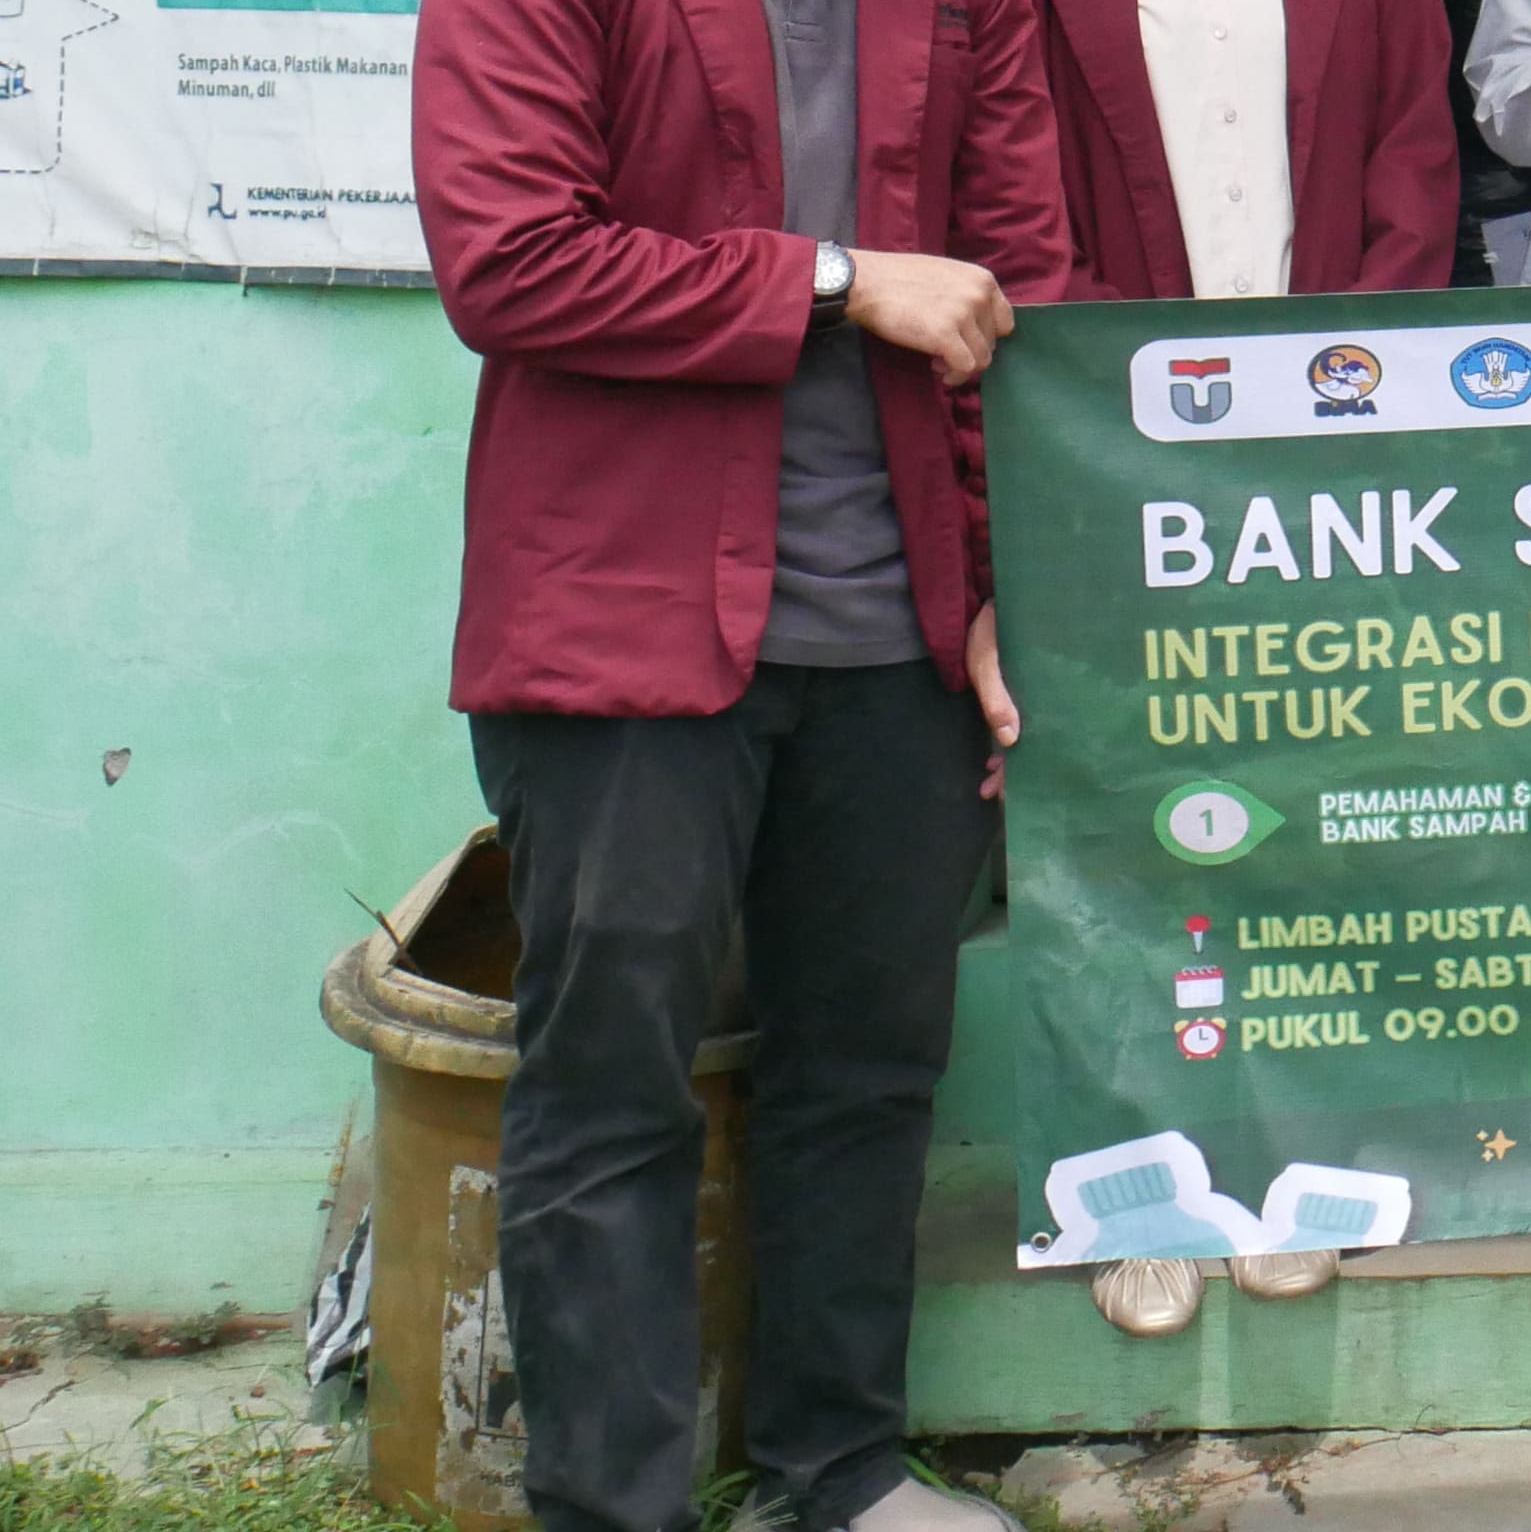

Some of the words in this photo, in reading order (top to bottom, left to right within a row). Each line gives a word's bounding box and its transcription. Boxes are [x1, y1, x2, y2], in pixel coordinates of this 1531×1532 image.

[177, 53, 239, 76] Sampah
[243, 55, 283, 75] Kaca,
[284, 55, 333, 75] Plastik
[336, 57, 409, 78] Makanan
[176, 79, 255, 101] Minuman,
[256, 80, 277, 99] dll
[247, 187, 334, 202] KEMENTERIAN
[1142, 486, 1461, 588] BANK
[1145, 611, 1501, 681] INTEGRASI
[1149, 684, 1373, 746] UNTUK
[1319, 783, 1503, 817] PEMAHAMAN
[1199, 808, 1216, 838] 1
[1321, 815, 1402, 845] BANK
[1410, 810, 1528, 840] SAMPAH
[1238, 912, 1392, 951] LIMBAH
[1241, 960, 1380, 1002] JUMAT
[1241, 1011, 1370, 1051] PUKUL
[1384, 1004, 1520, 1041] 09.00
